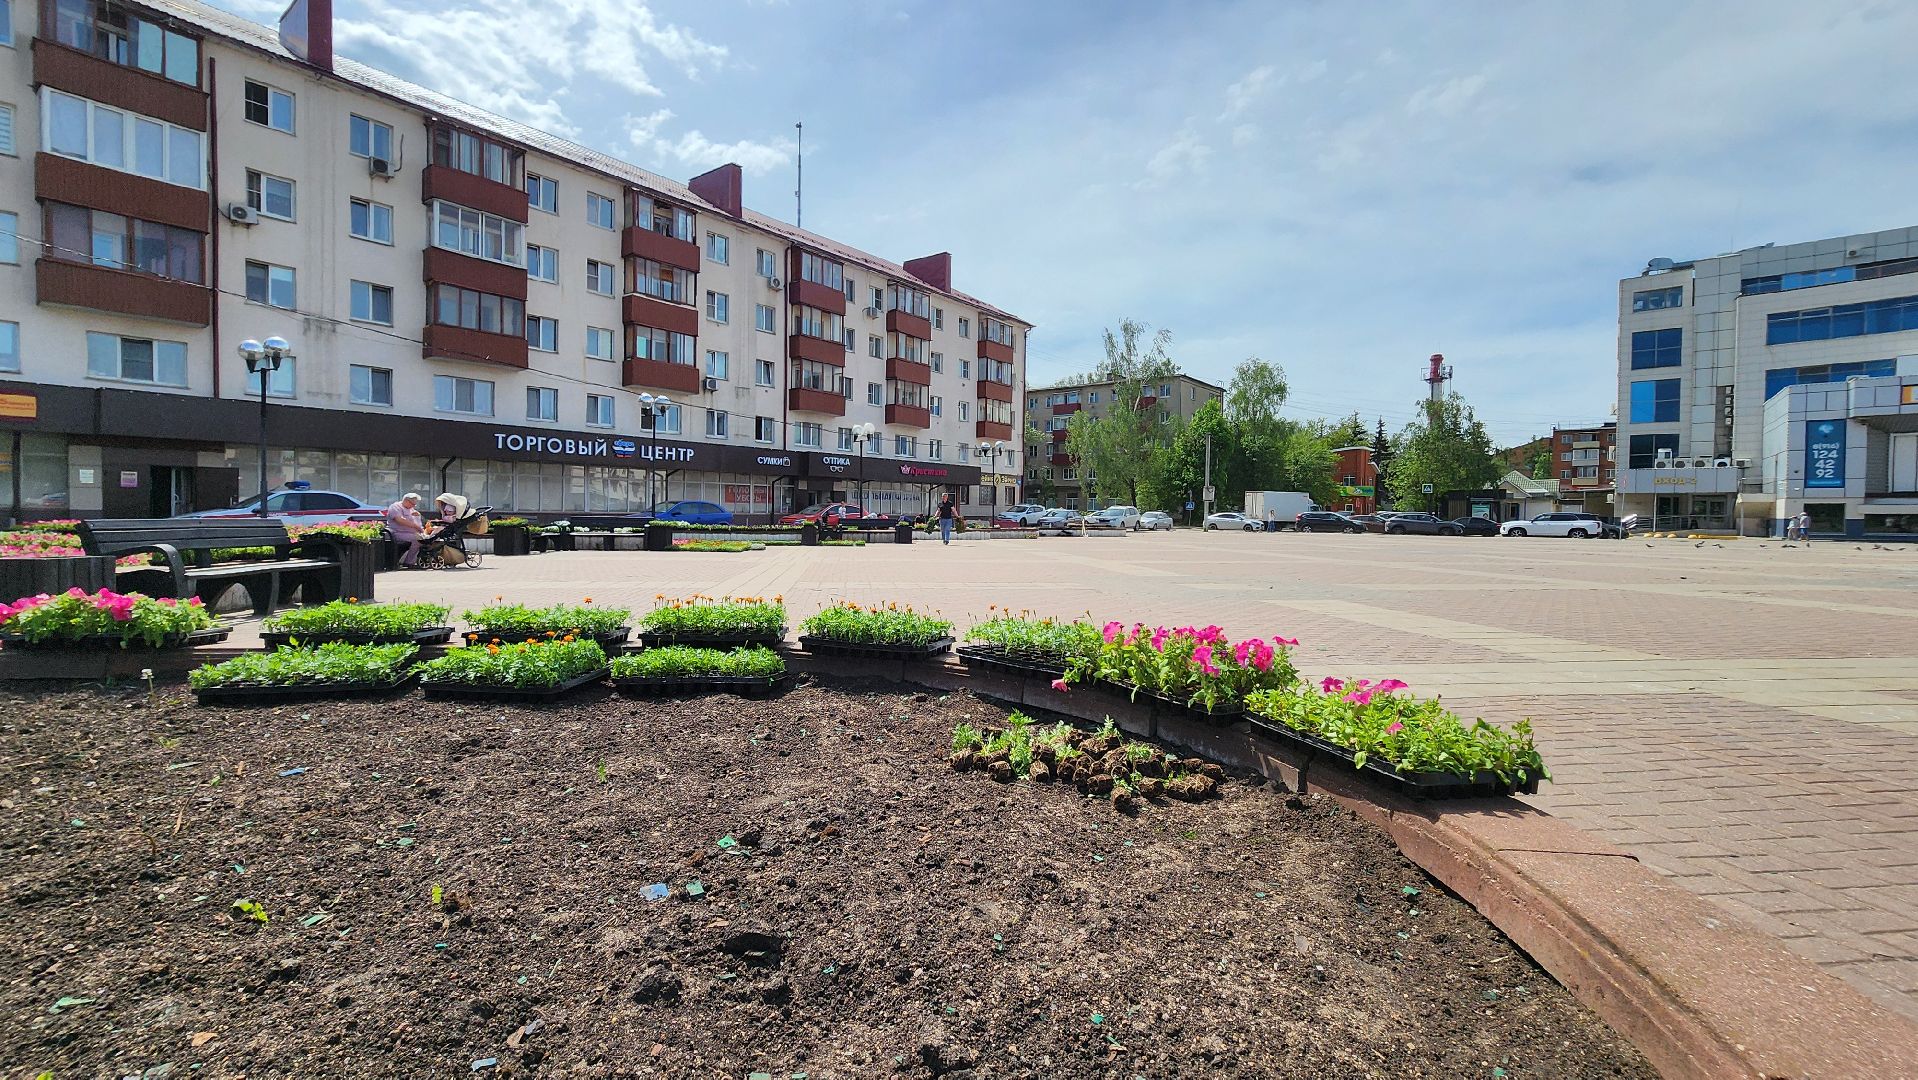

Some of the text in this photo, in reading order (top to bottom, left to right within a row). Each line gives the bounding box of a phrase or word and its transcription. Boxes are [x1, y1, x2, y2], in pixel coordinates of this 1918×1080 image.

[494, 433, 607, 457] ТОРГОВЫЙ
[641, 444, 695, 461] ЦЕНТР
[1812, 450, 1839, 459] 124
[757, 456, 783, 466] СУМКИ
[823, 456, 851, 466] ОПТИКА
[1815, 459, 1835, 469] 42
[1815, 469, 1835, 478] 92
